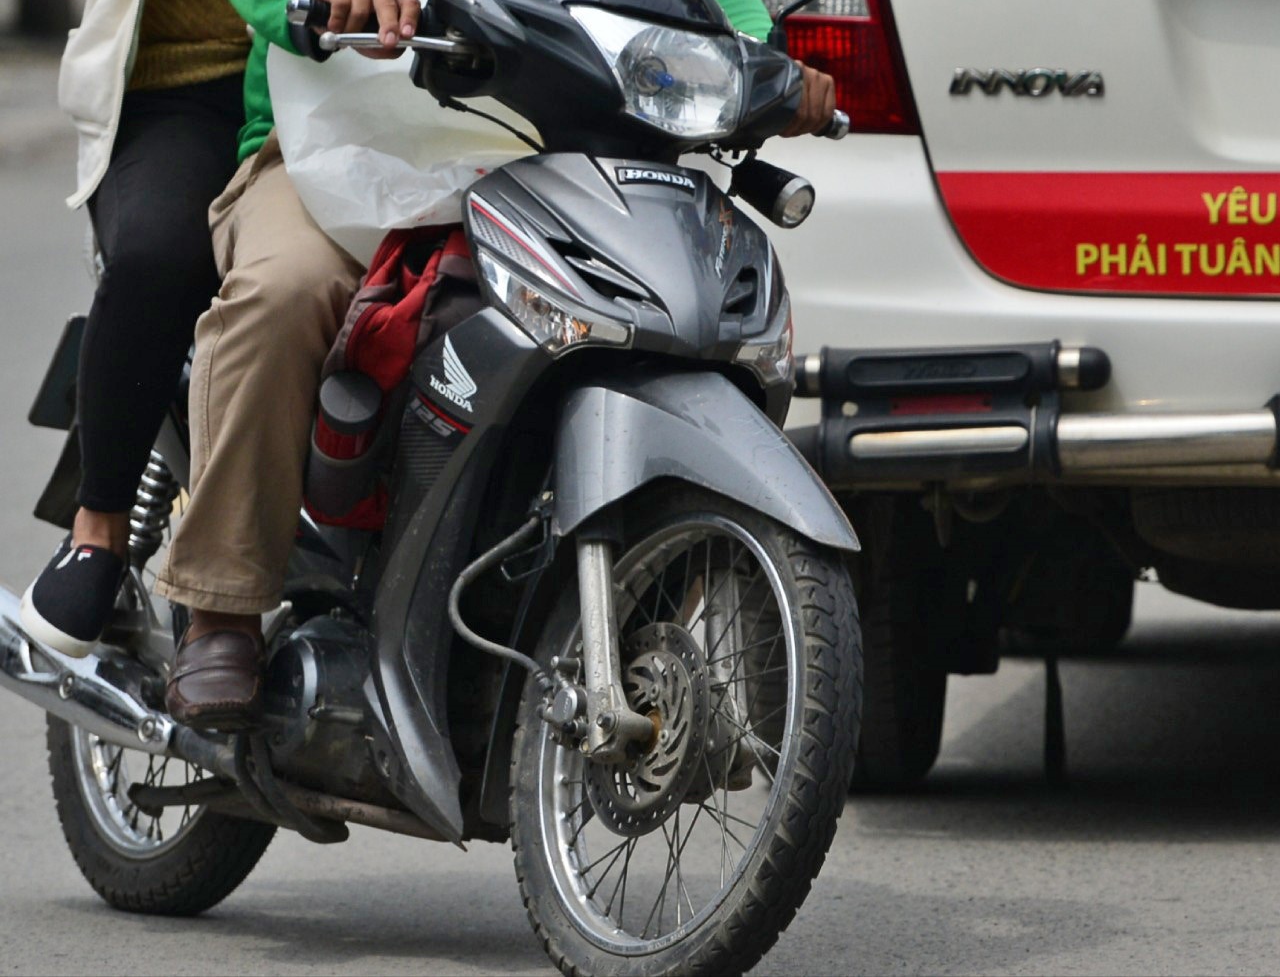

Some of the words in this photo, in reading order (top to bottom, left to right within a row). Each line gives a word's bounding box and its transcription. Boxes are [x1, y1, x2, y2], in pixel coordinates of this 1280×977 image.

[949, 67, 1106, 98] INNOVA
[624, 168, 696, 189] HONDA
[1201, 184, 1278, 225] YÊU
[1075, 233, 1167, 276] PHẢI
[429, 374, 473, 413] HONDA
